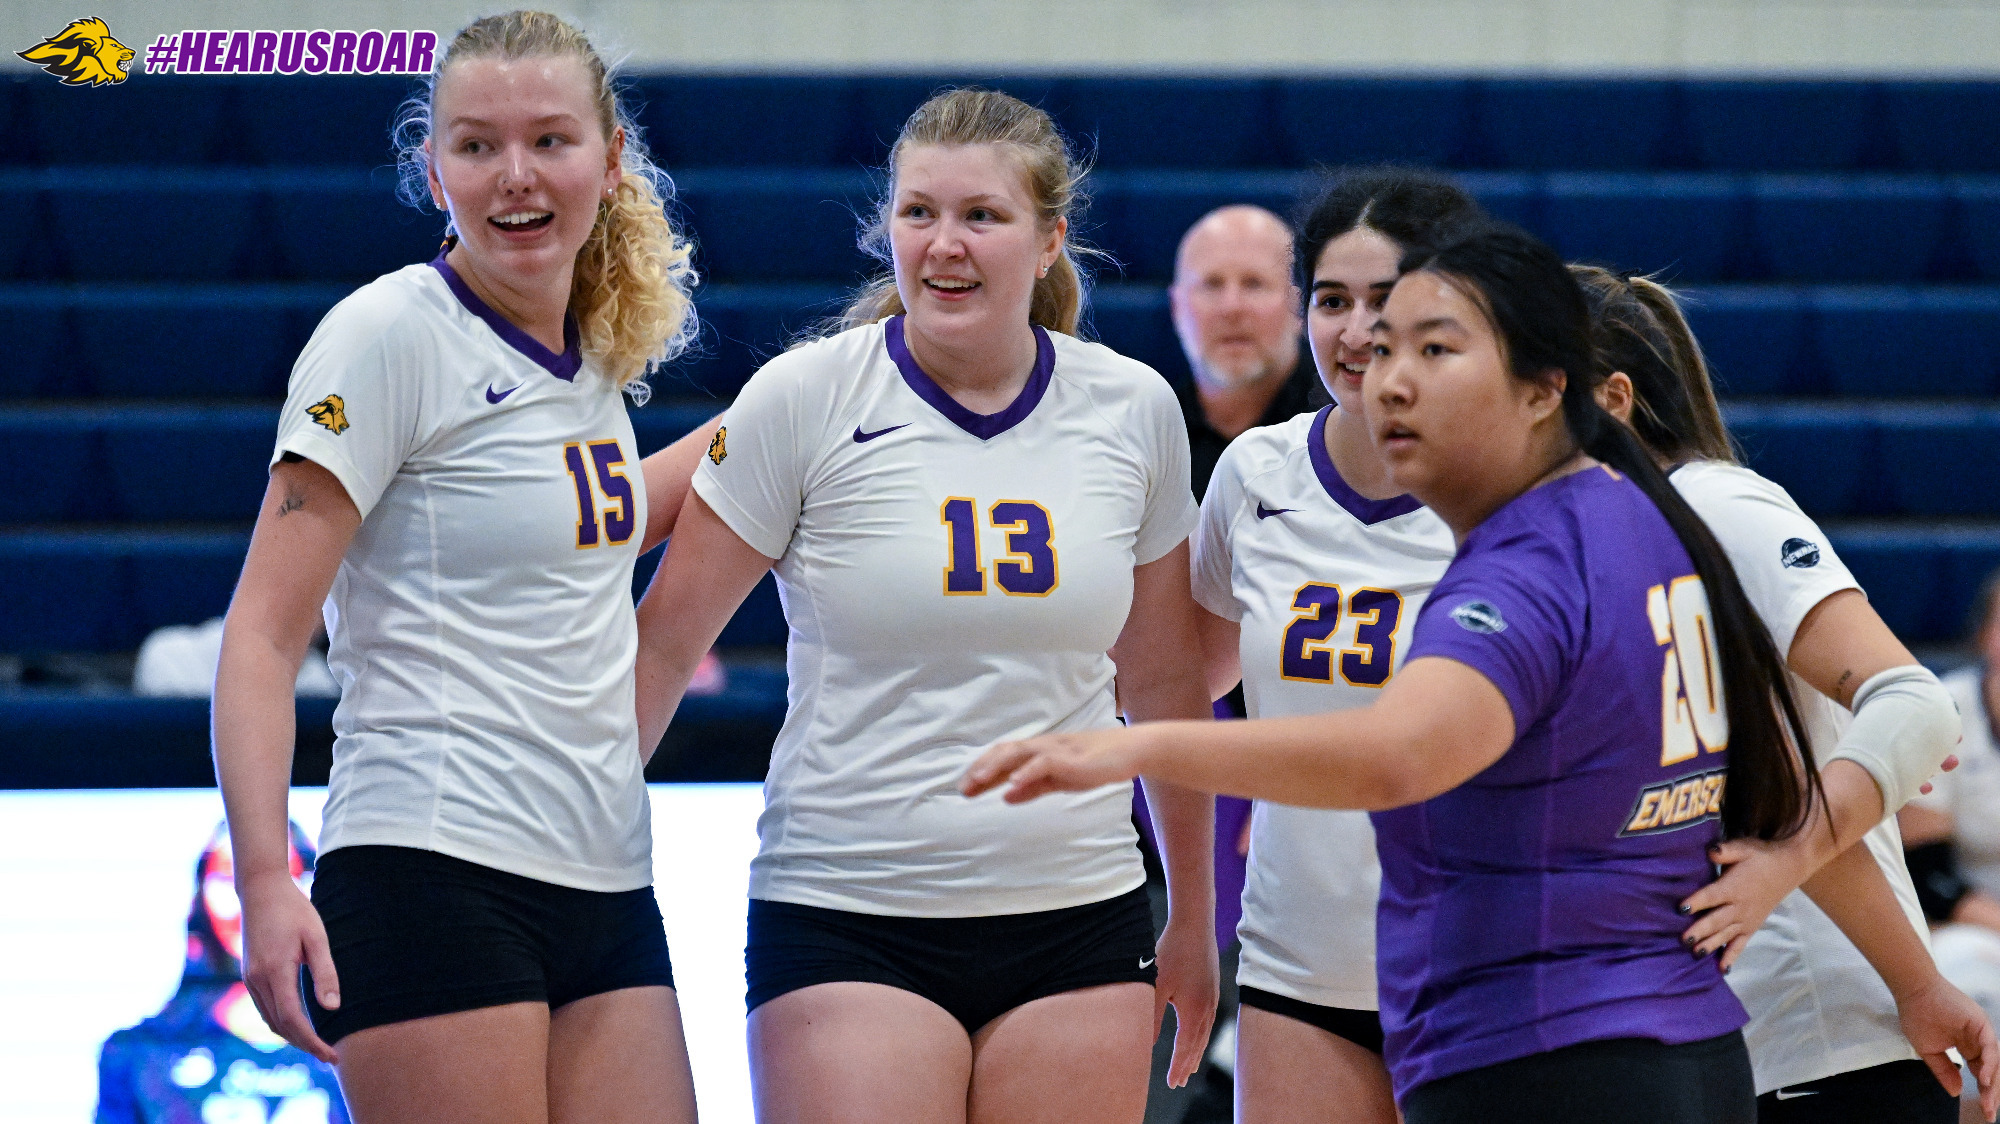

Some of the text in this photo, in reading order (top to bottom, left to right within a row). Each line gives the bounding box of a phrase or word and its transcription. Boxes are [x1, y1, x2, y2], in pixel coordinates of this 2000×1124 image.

[563, 438, 636, 550] 15
[940, 495, 1060, 598] 13
[1280, 580, 1405, 689] 23
[1646, 574, 1729, 767] 20
